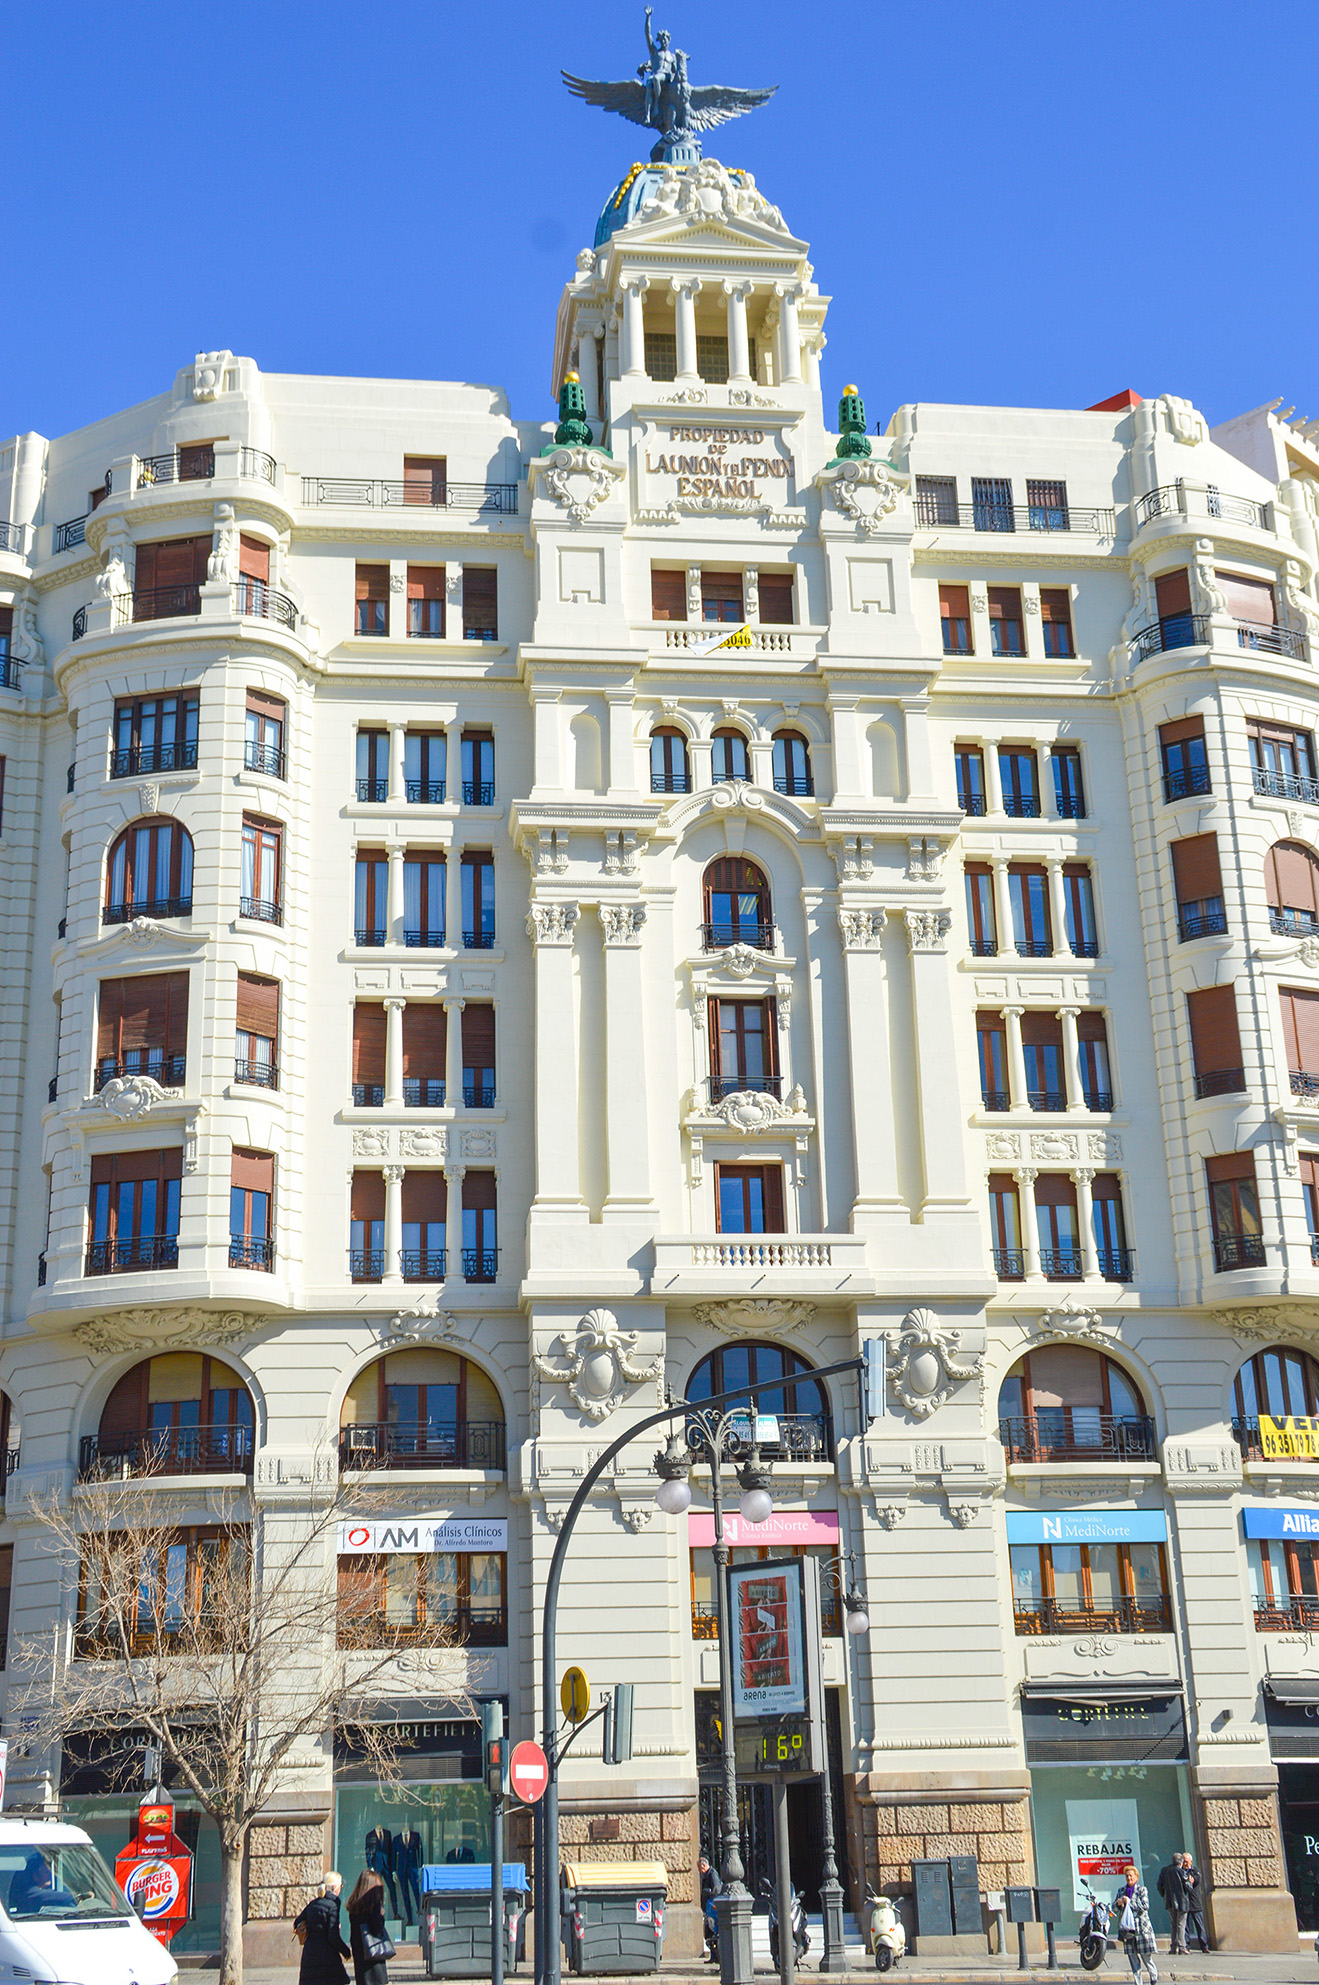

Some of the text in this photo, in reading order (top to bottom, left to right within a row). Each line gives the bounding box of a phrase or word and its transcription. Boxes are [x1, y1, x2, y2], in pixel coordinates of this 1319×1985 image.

[670, 426, 765, 444] PROPIEDAD
[708, 445, 727, 454] DE
[678, 476, 762, 499] ESPAÑOL
[425, 1525, 502, 1538] Análisis Clínicos
[741, 1519, 808, 1532] MediNorte
[1065, 1524, 1130, 1537] MediNorte
[600, 1691, 612, 1703] 13
[1077, 1843, 1133, 1855] REBAJAS
[132, 1871, 171, 1892] BURGER
[140, 1880, 172, 1900] ING
